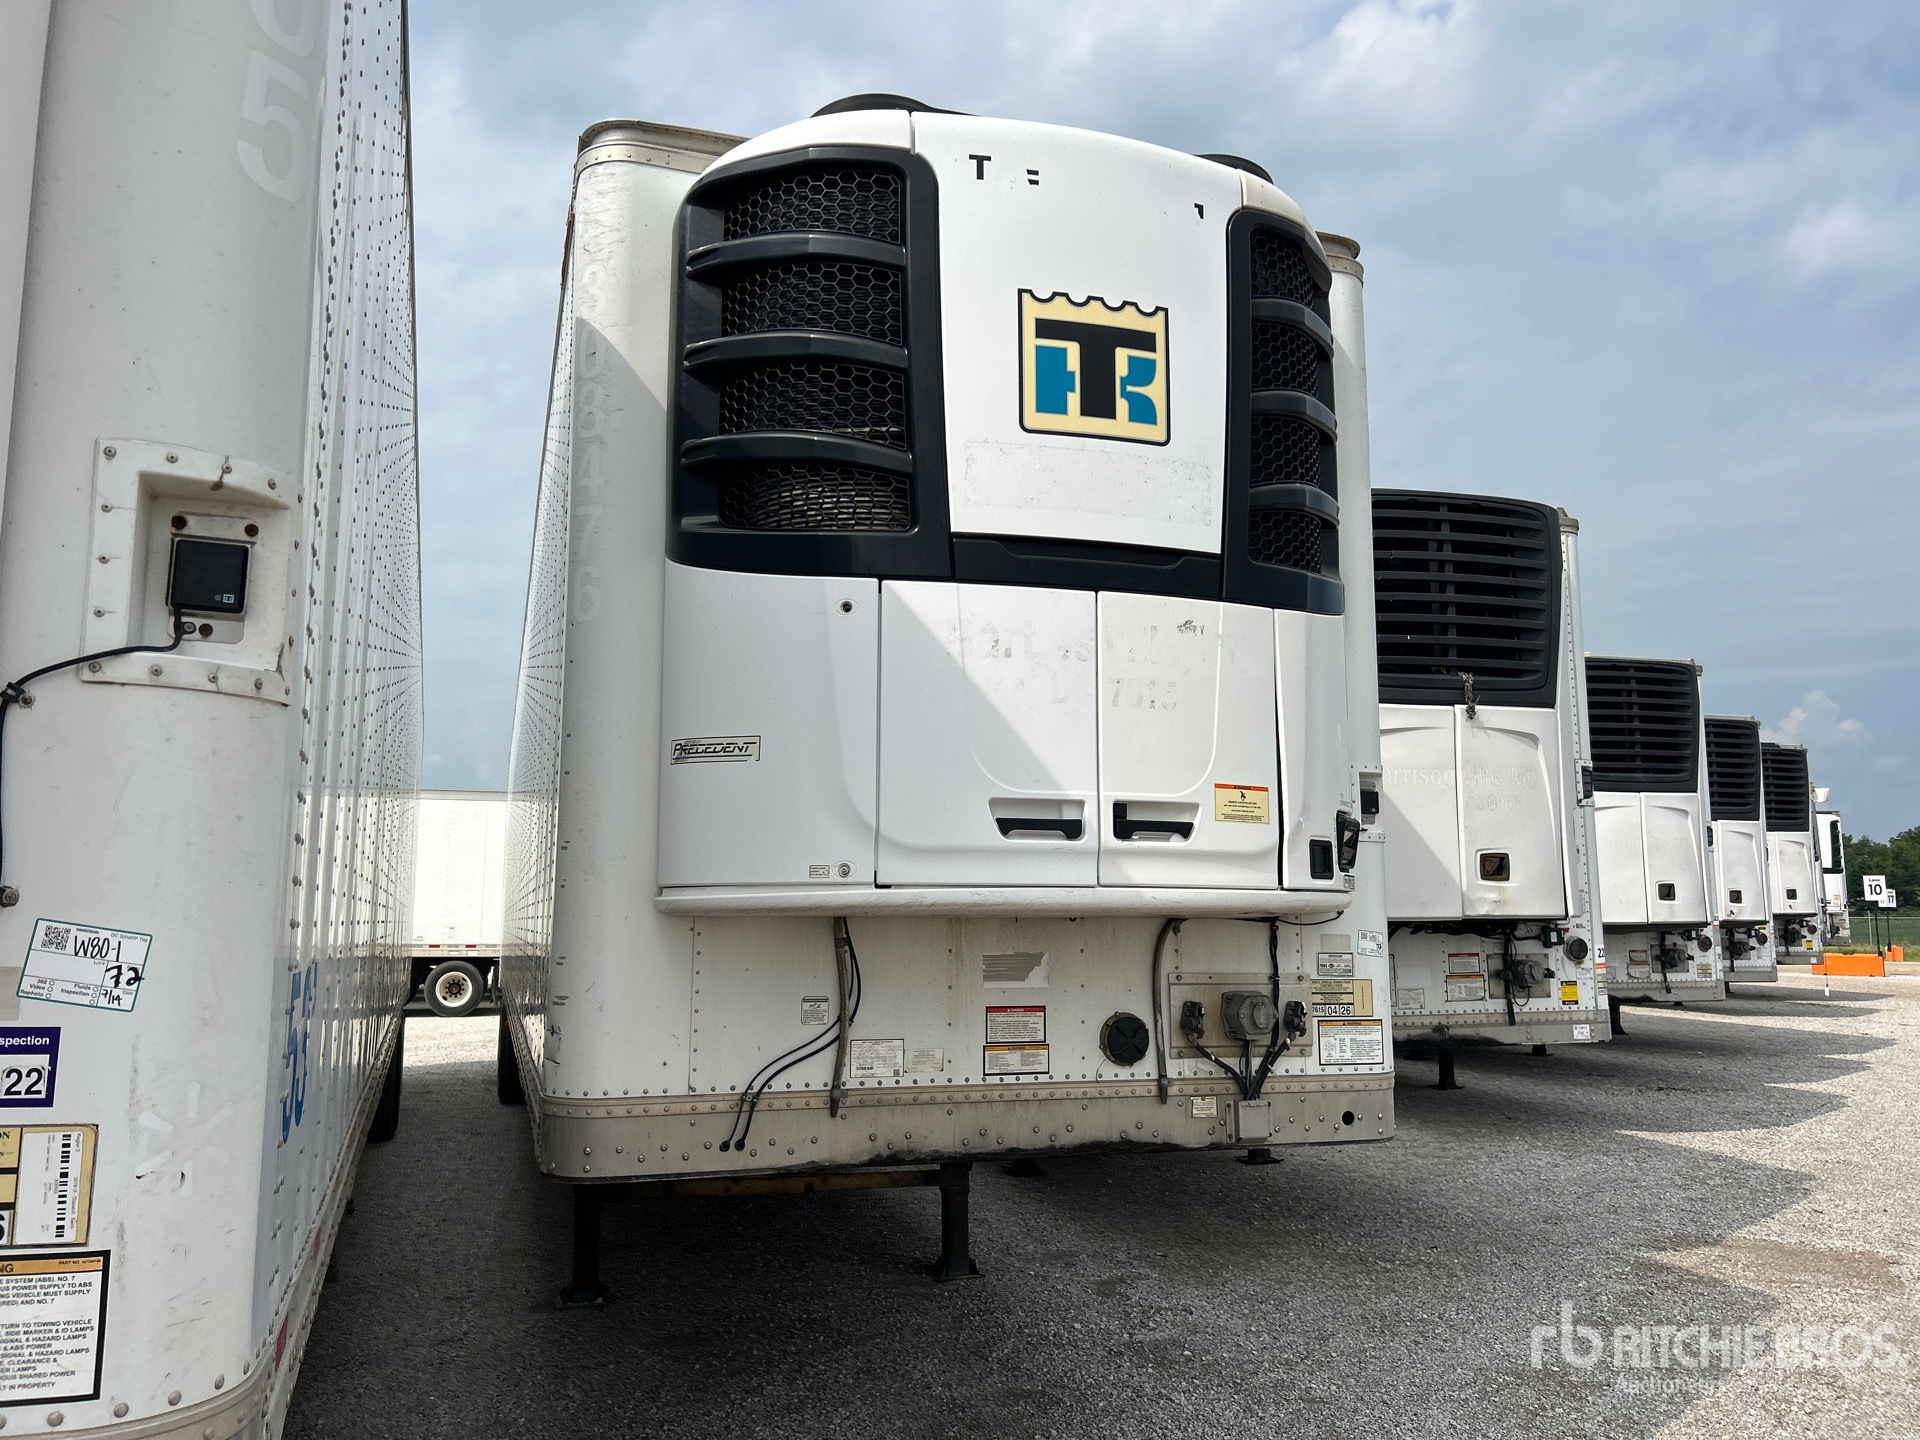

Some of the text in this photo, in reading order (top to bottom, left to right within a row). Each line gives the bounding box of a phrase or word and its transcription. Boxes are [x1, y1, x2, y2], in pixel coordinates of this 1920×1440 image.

[1867, 883, 1883, 896] 10
[1327, 1005, 1338, 1015] 04
[1340, 1005, 1351, 1015] 26
[3, 1067, 43, 1096] 22
[64, 1288, 91, 1296] SUPPLY
[62, 1318, 92, 1326] VEHICLE
[70, 1325, 95, 1333] LAMPS
[66, 1347, 90, 1355] LAMPS
[8, 1357, 51, 1366] CLEARANCE
